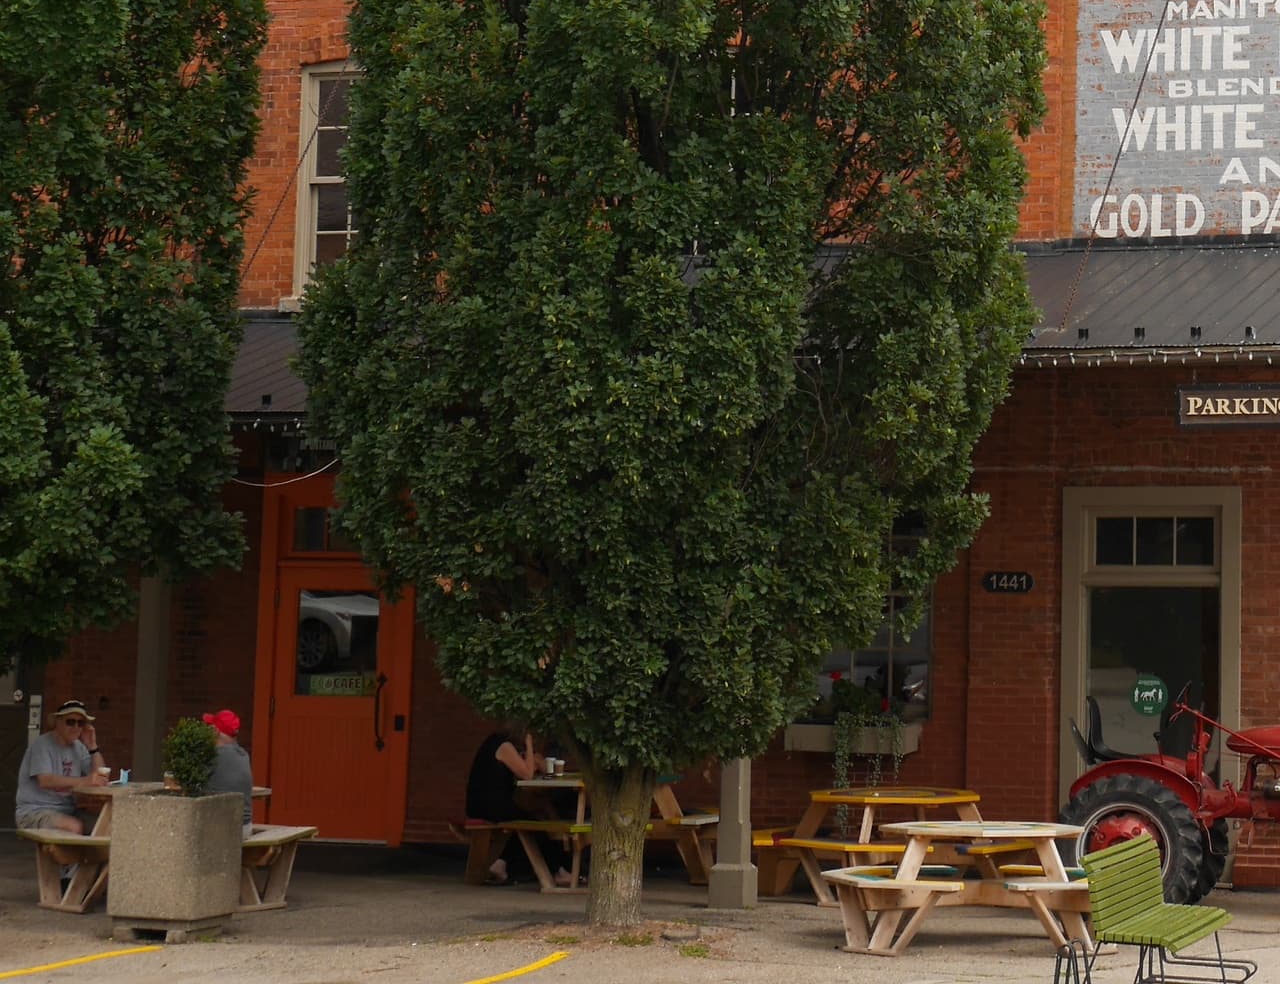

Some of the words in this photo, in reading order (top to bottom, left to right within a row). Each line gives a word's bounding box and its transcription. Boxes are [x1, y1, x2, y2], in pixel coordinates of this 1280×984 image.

[1100, 25, 1251, 73] WHITE
[1112, 103, 1265, 151] WHITE
[1090, 193, 1205, 238] GOLD
[989, 574, 1027, 590] 1441
